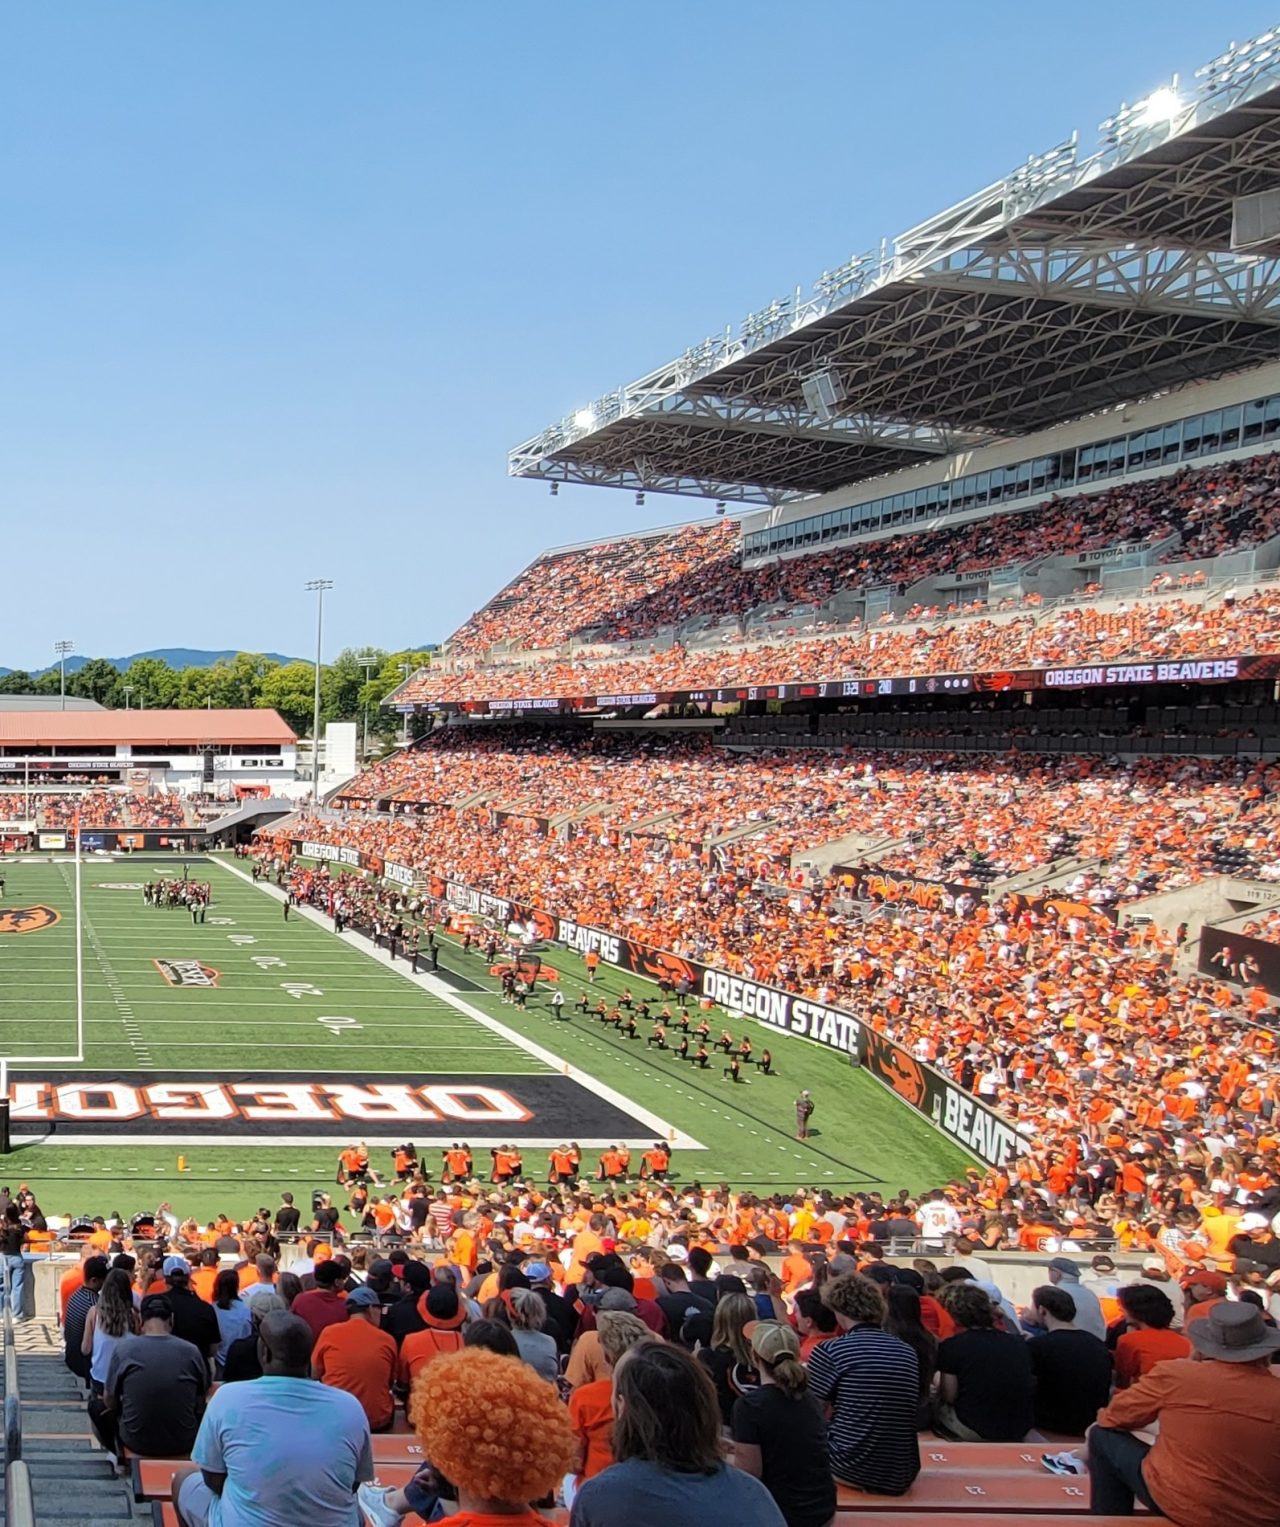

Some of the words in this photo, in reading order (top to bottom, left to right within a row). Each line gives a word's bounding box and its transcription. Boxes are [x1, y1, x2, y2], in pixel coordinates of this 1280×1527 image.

[1089, 548, 1123, 560] TOYOTA
[1045, 668, 1103, 686] OREGON
[1106, 665, 1153, 683] STATE
[1157, 660, 1238, 681] BEAVERS
[302, 842, 340, 861] OREGON
[340, 847, 360, 866] STATE
[558, 920, 620, 963] BEAVERS
[280, 982, 323, 997] 20
[317, 1016, 363, 1030] 10
[703, 970, 789, 1027] OREGON
[791, 1000, 860, 1055] STATE
